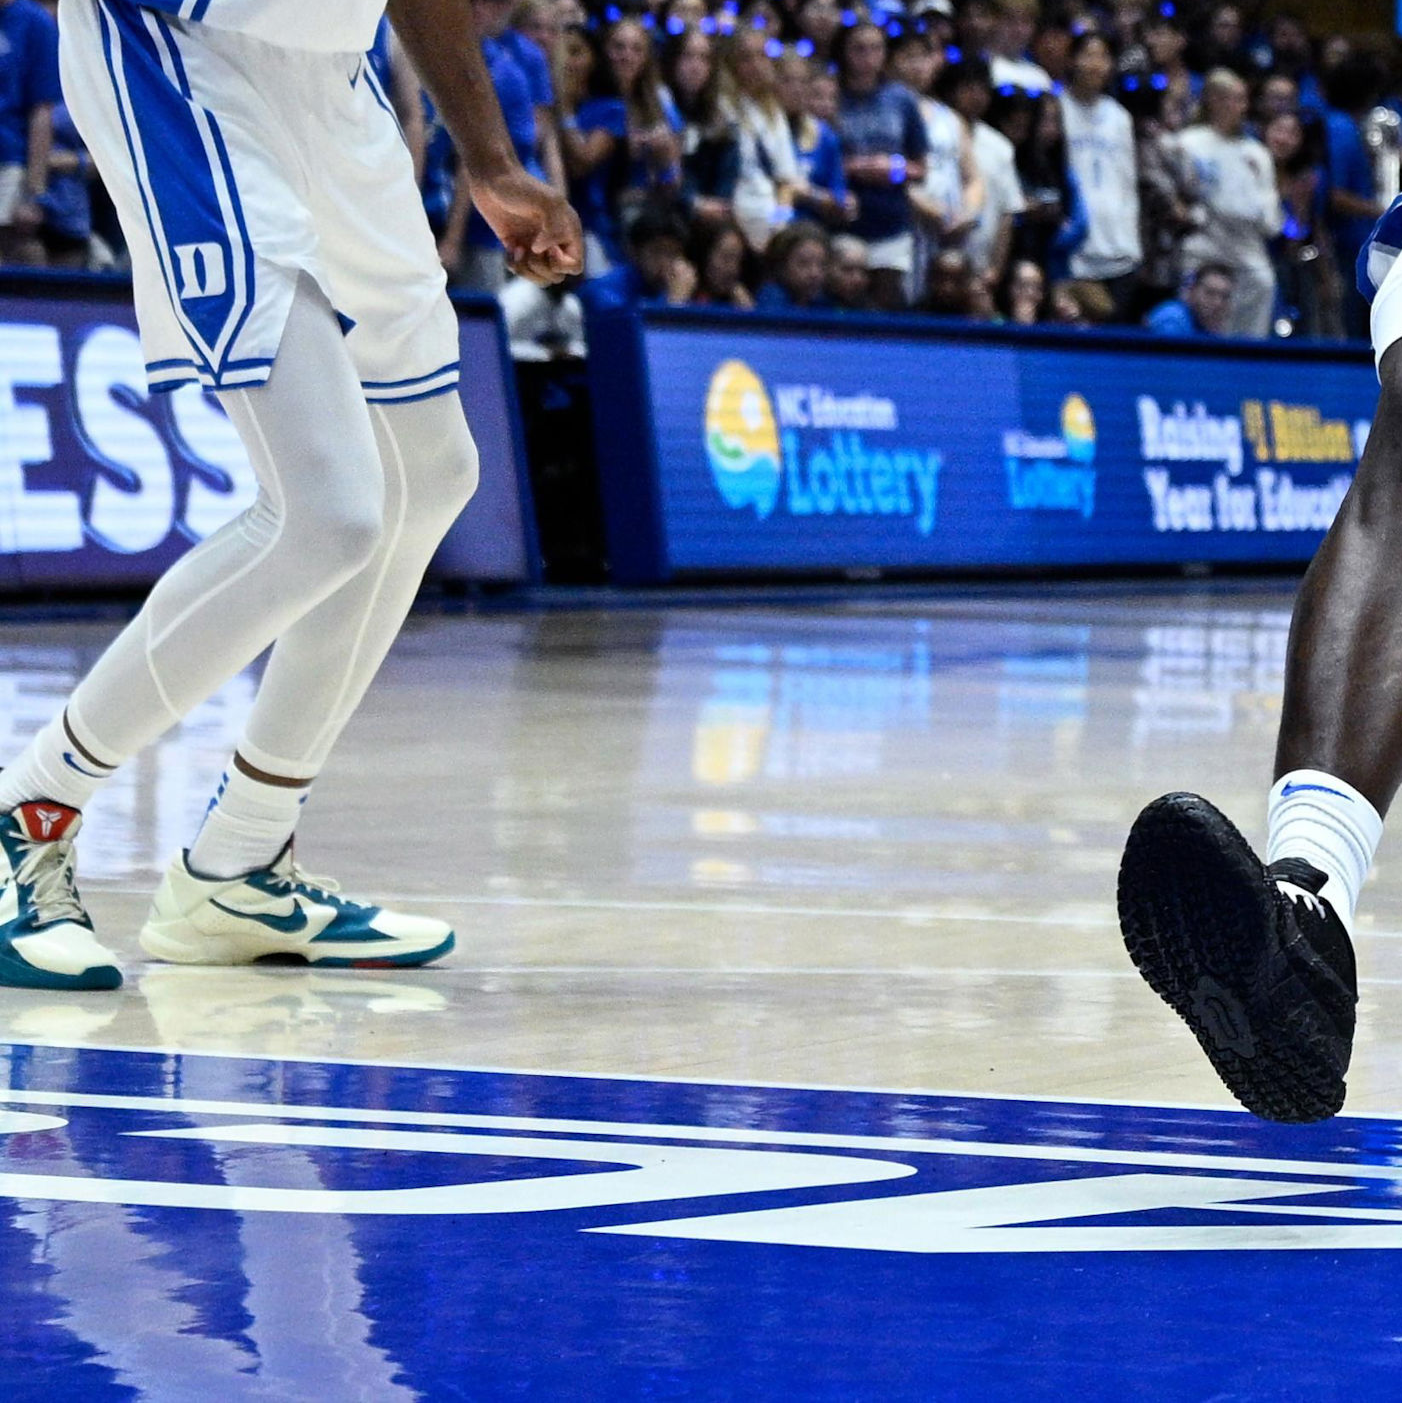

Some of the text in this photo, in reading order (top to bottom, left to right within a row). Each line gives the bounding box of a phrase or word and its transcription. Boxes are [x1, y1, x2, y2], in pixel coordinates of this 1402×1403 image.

[173, 242, 226, 300] D
[0, 323, 260, 555] ESS
[785, 429, 942, 536] Lottery
